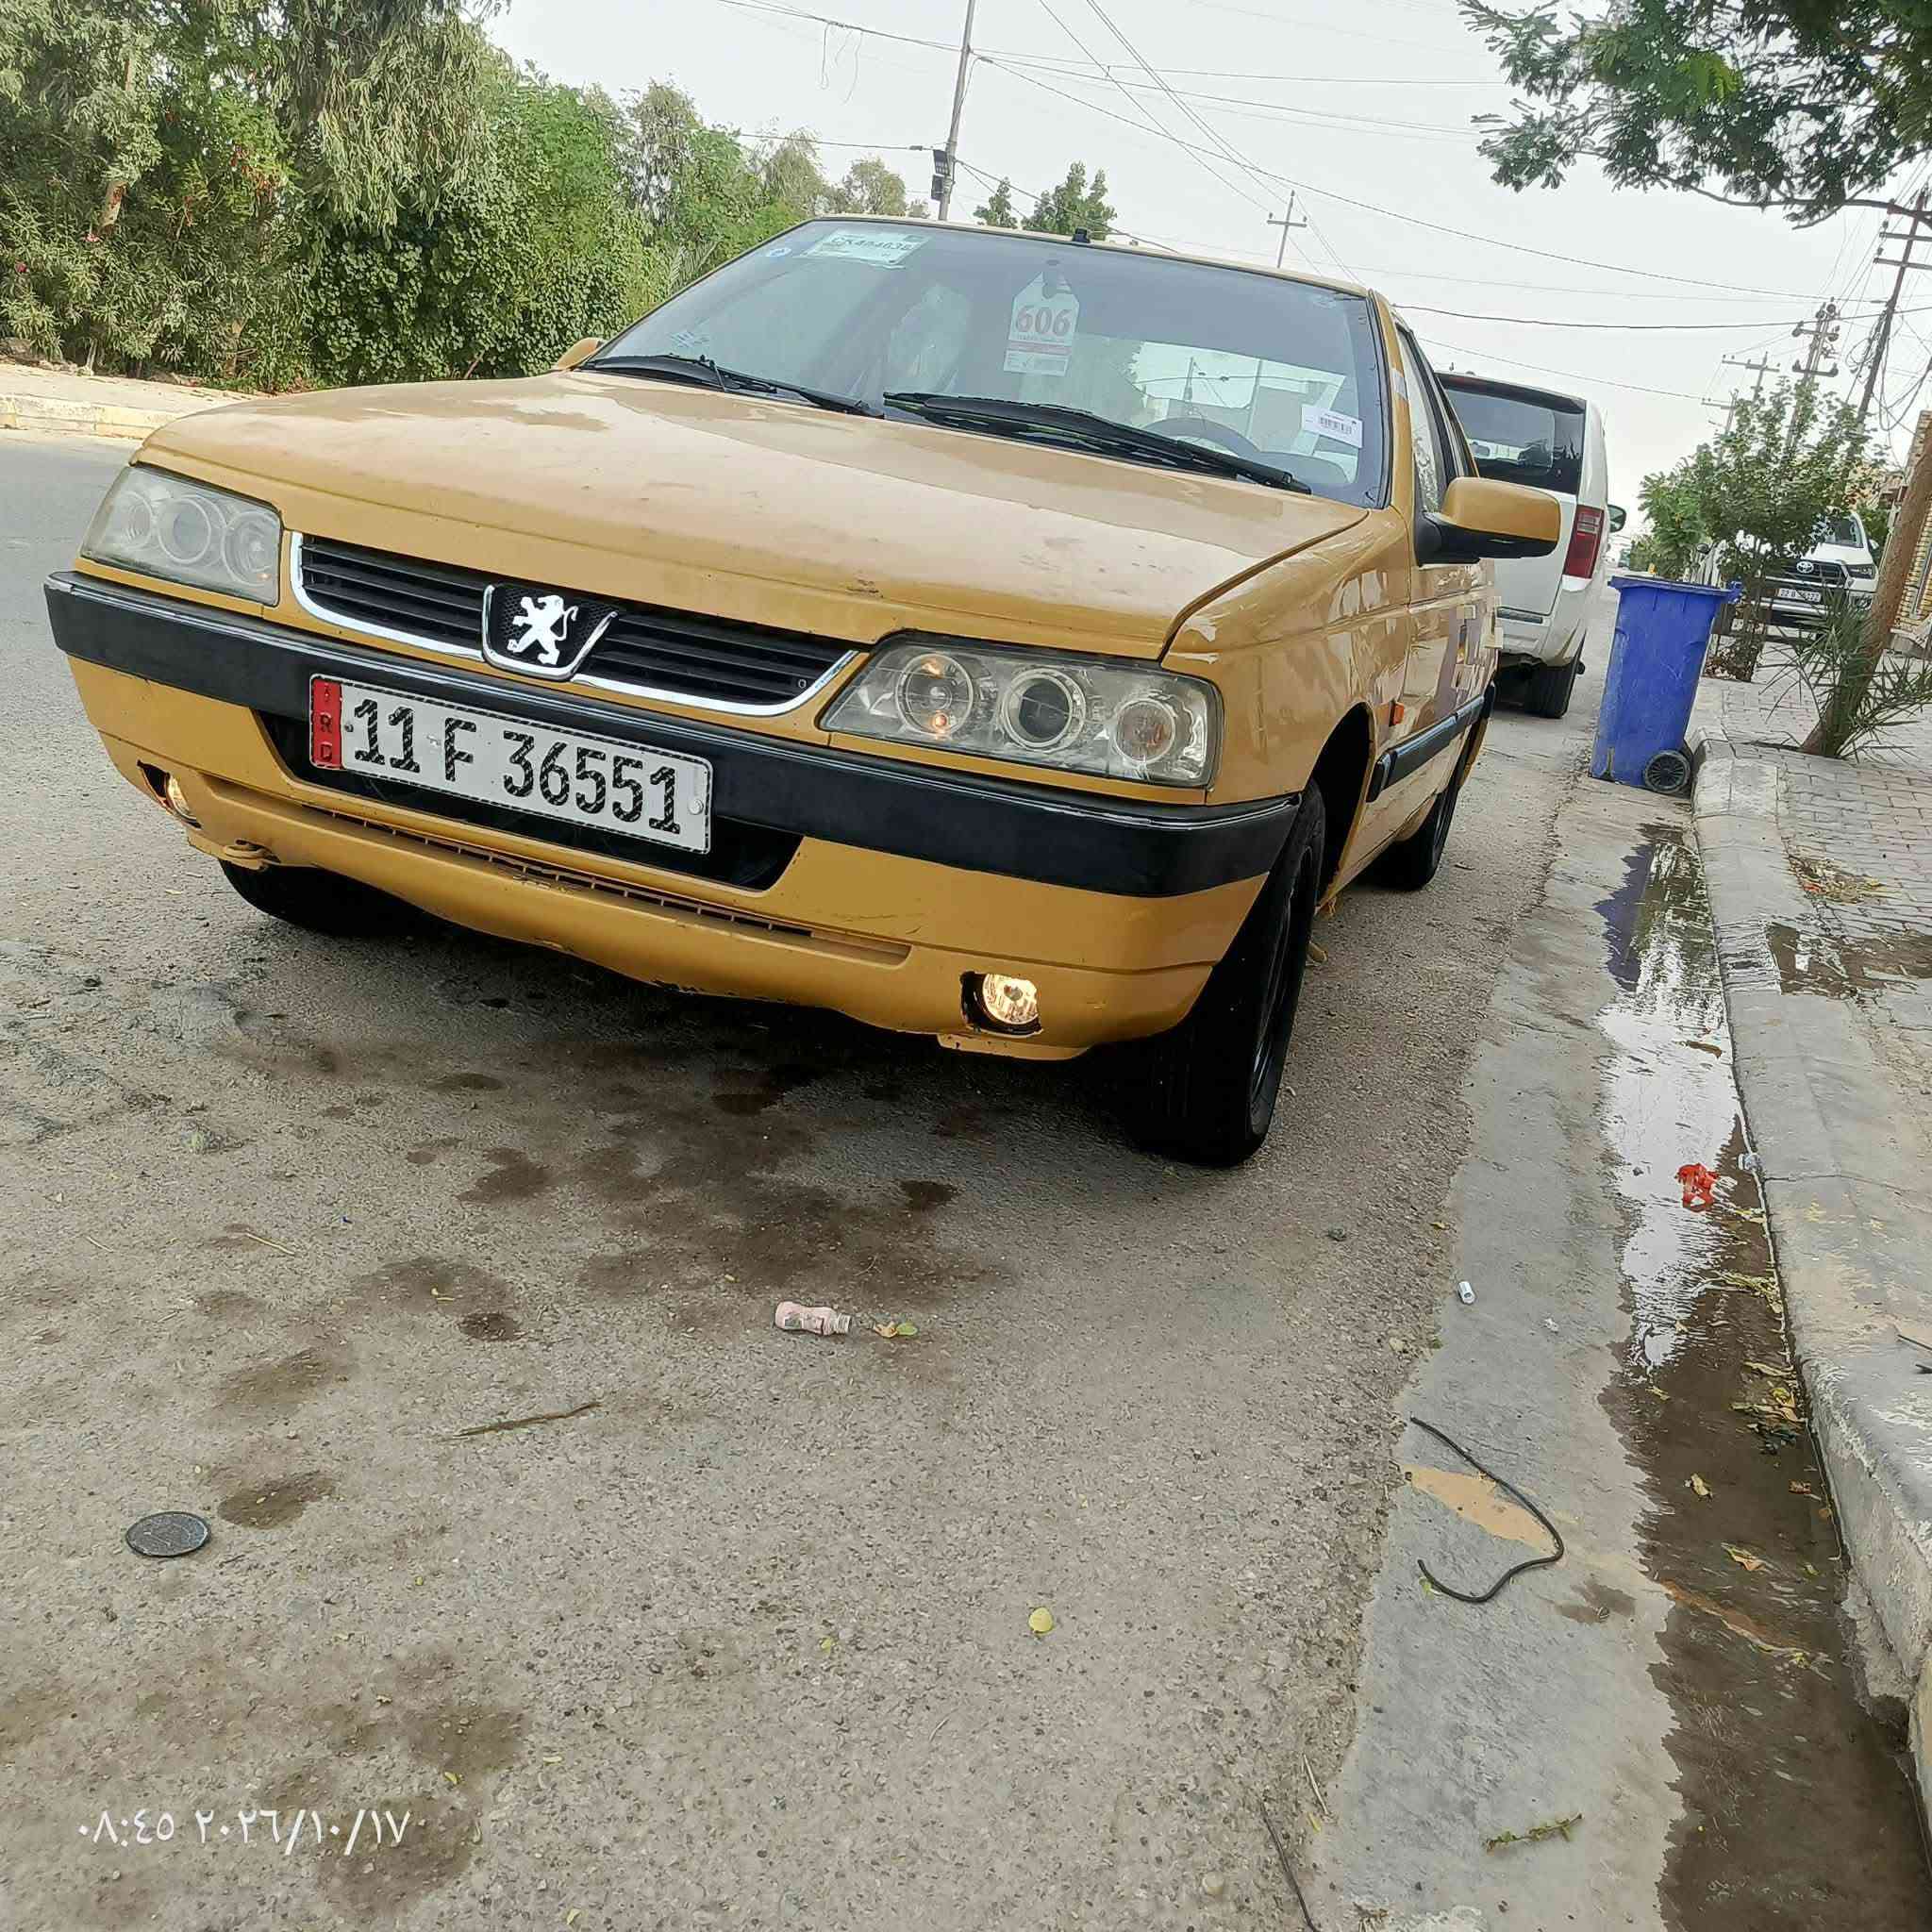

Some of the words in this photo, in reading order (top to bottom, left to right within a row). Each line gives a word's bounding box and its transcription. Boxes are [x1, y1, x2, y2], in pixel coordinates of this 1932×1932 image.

[1015, 304, 1072, 336] 606
[354, 698, 420, 774] 11
[443, 717, 476, 783] F
[503, 730, 681, 835] 36551
